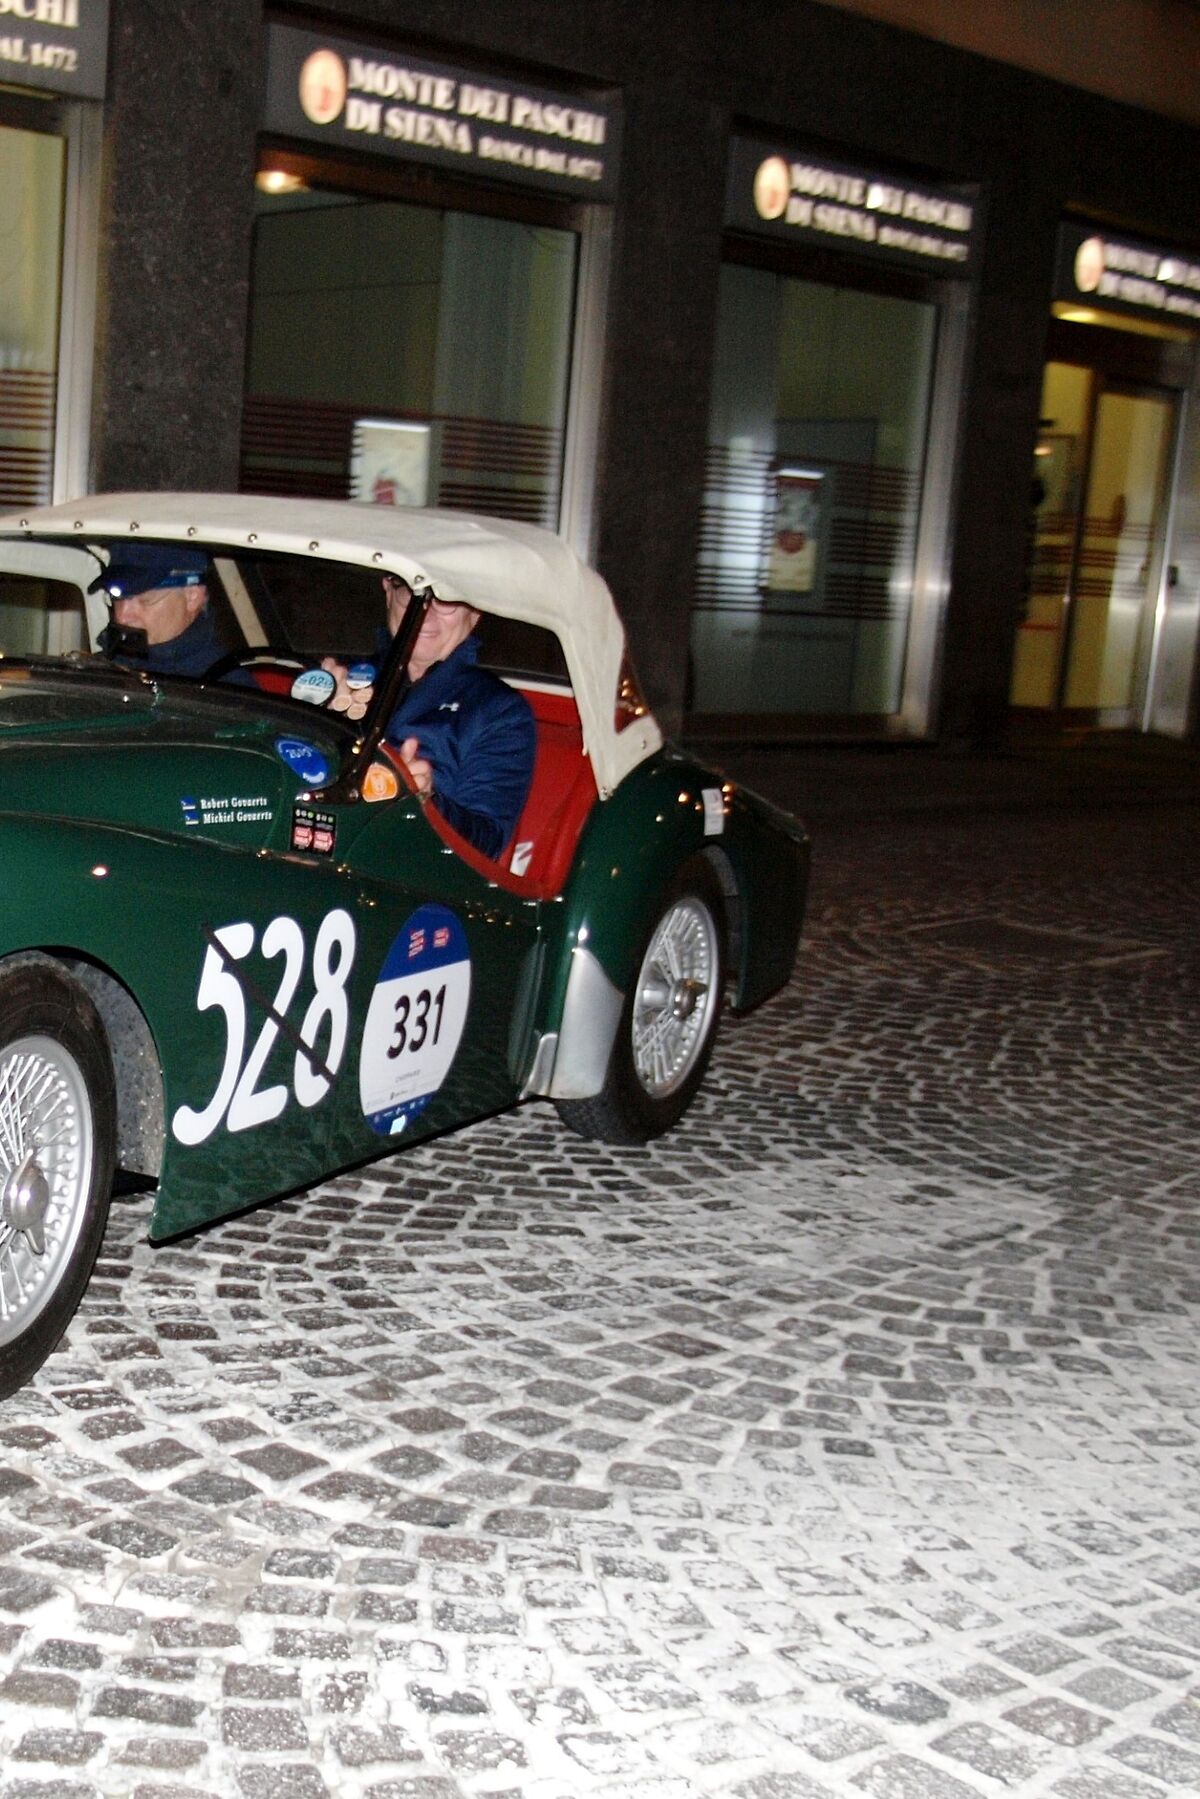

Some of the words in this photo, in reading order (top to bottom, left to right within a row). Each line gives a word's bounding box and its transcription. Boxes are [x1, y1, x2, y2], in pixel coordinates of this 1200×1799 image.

[31, 42, 79, 73] 1472
[345, 98, 383, 134] DI
[383, 107, 474, 155] SIENA
[348, 57, 457, 112] MONTE
[457, 83, 511, 123] DEI
[511, 95, 607, 145] PASCHI
[200, 798, 228, 810] Robert
[172, 908, 356, 1146] 528
[387, 984, 447, 1060] 331
